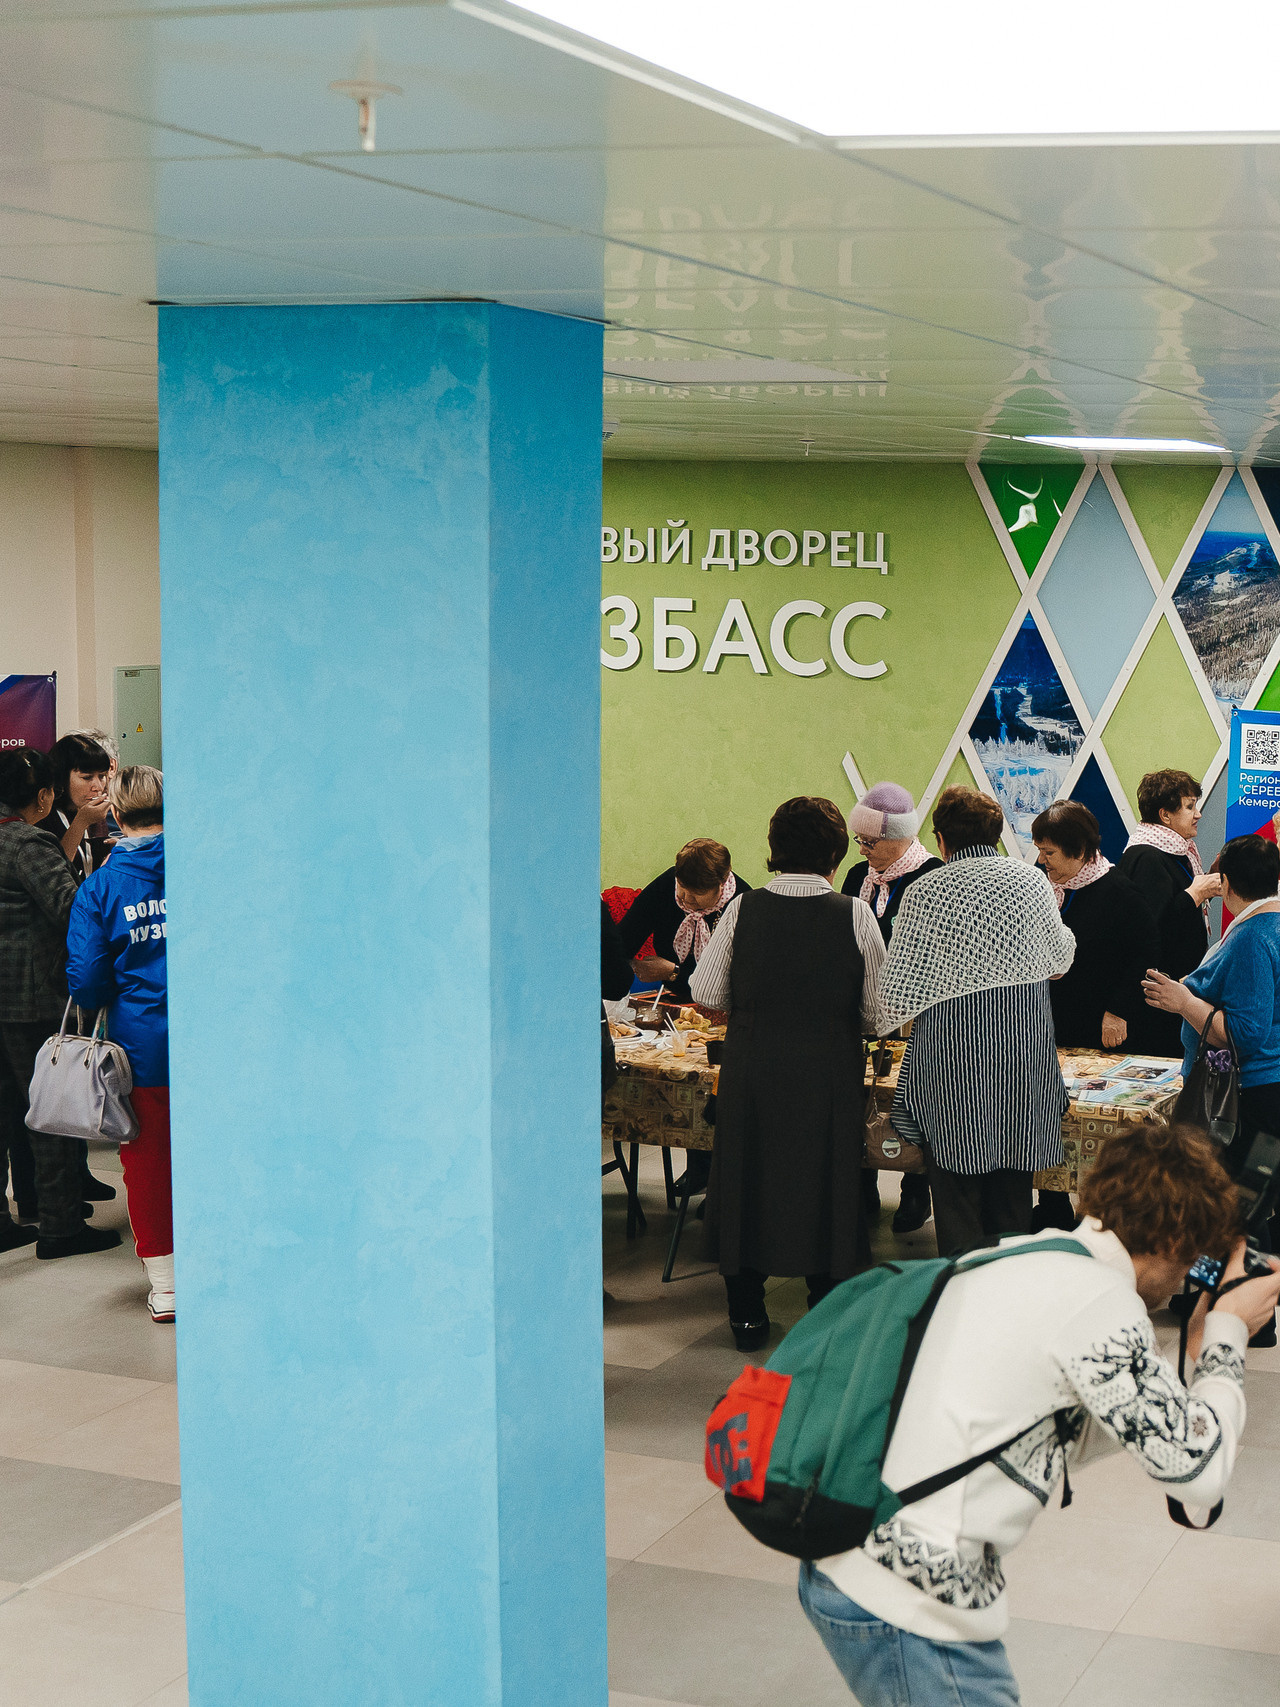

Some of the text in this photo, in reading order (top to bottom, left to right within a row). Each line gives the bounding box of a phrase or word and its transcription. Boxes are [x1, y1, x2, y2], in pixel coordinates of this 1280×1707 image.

[601, 519, 888, 575] ВЫЙ ДВОРЕЦ
[601, 595, 888, 679] ЗБАСС
[0, 738, 26, 749] ров
